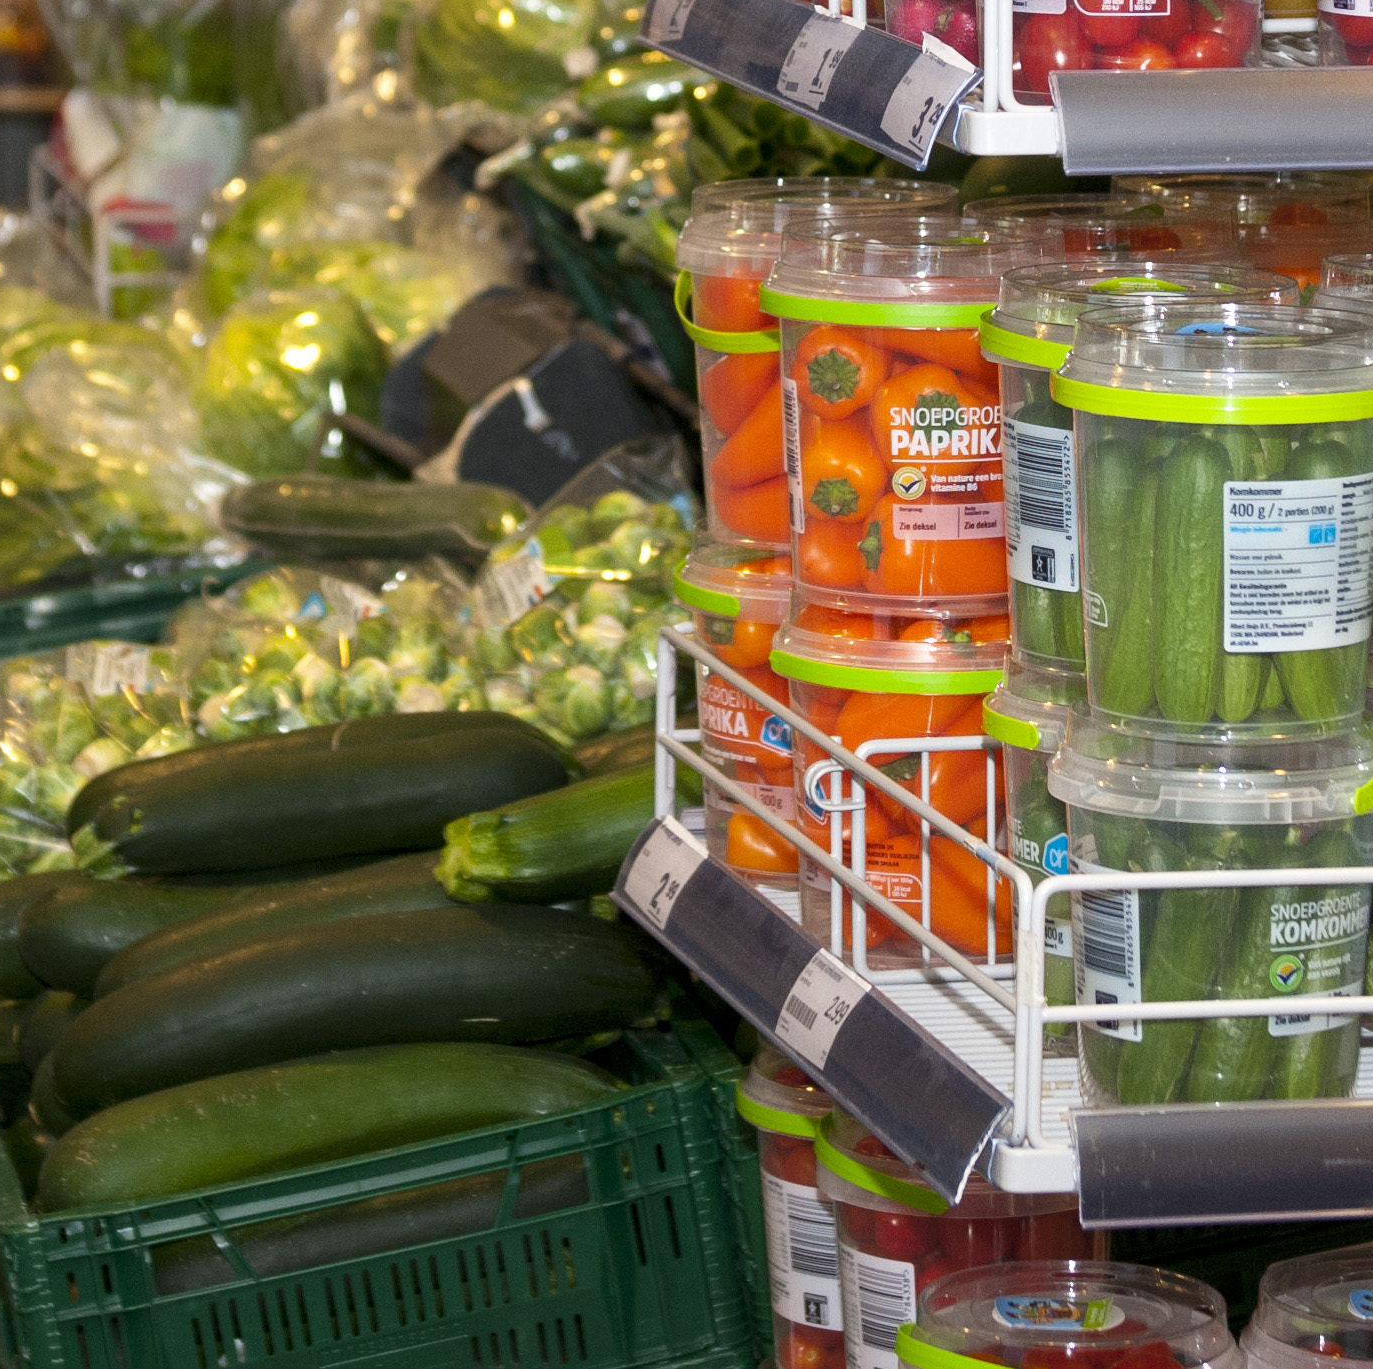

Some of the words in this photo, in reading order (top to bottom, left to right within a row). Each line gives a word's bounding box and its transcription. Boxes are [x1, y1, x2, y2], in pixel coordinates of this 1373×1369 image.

[1230, 503, 1254, 517] 400
[899, 523, 910, 531] Zie
[964, 520, 975, 529] Zie
[1270, 892, 1362, 920] SNOEPGROENTE
